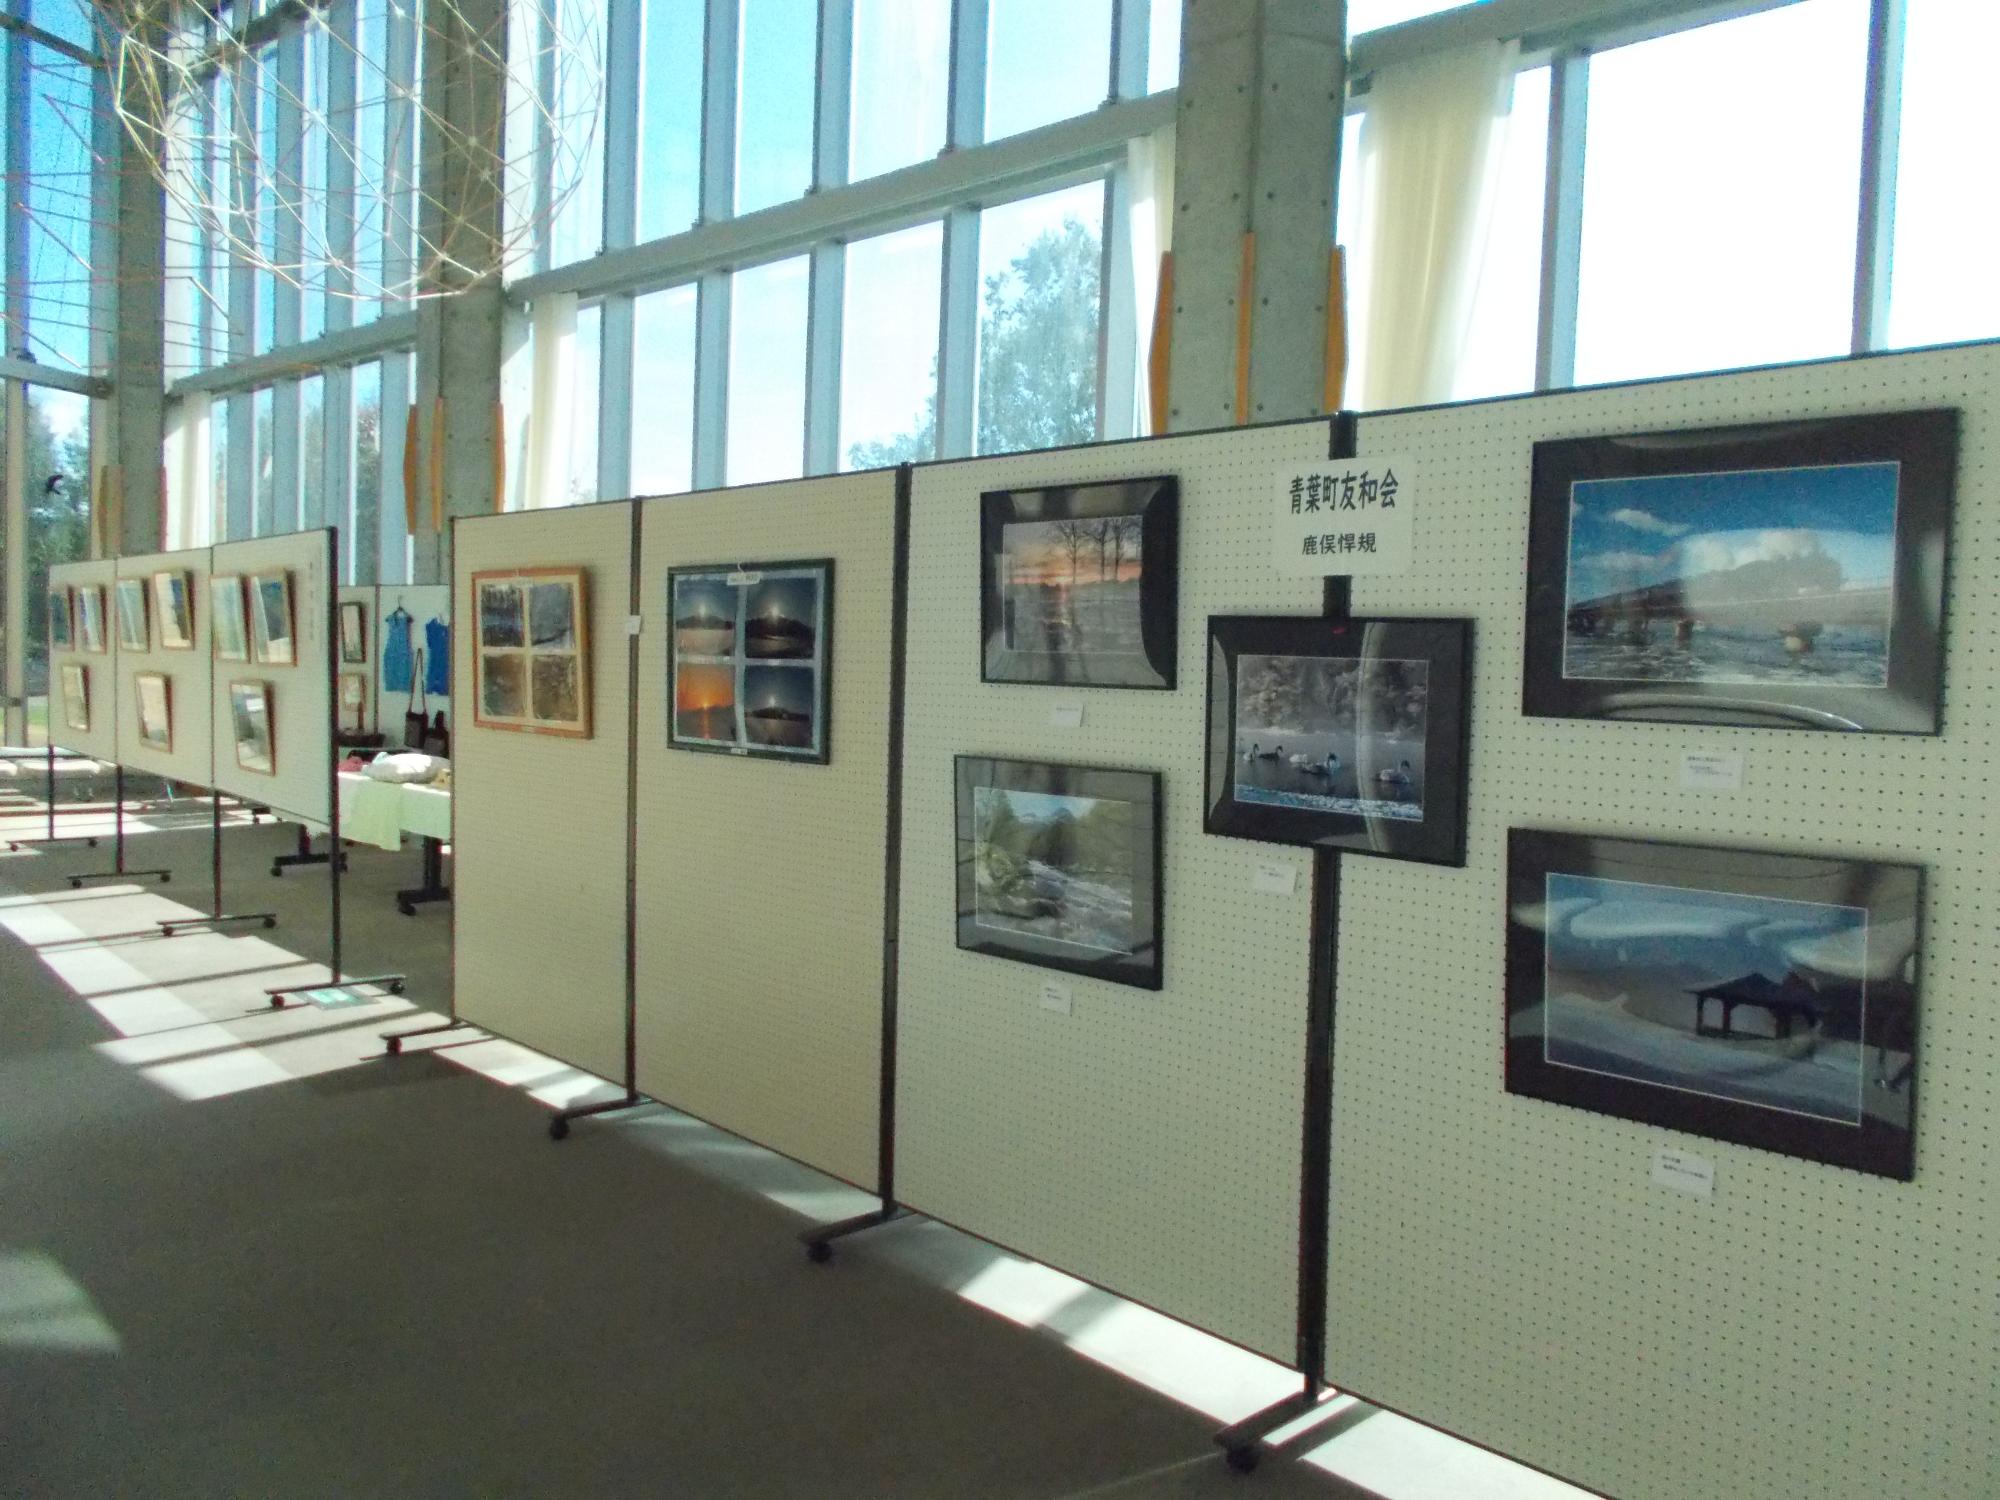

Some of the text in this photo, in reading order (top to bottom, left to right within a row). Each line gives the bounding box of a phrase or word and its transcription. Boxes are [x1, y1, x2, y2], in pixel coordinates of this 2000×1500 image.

[1289, 468, 1399, 514] 青葉町友和会
